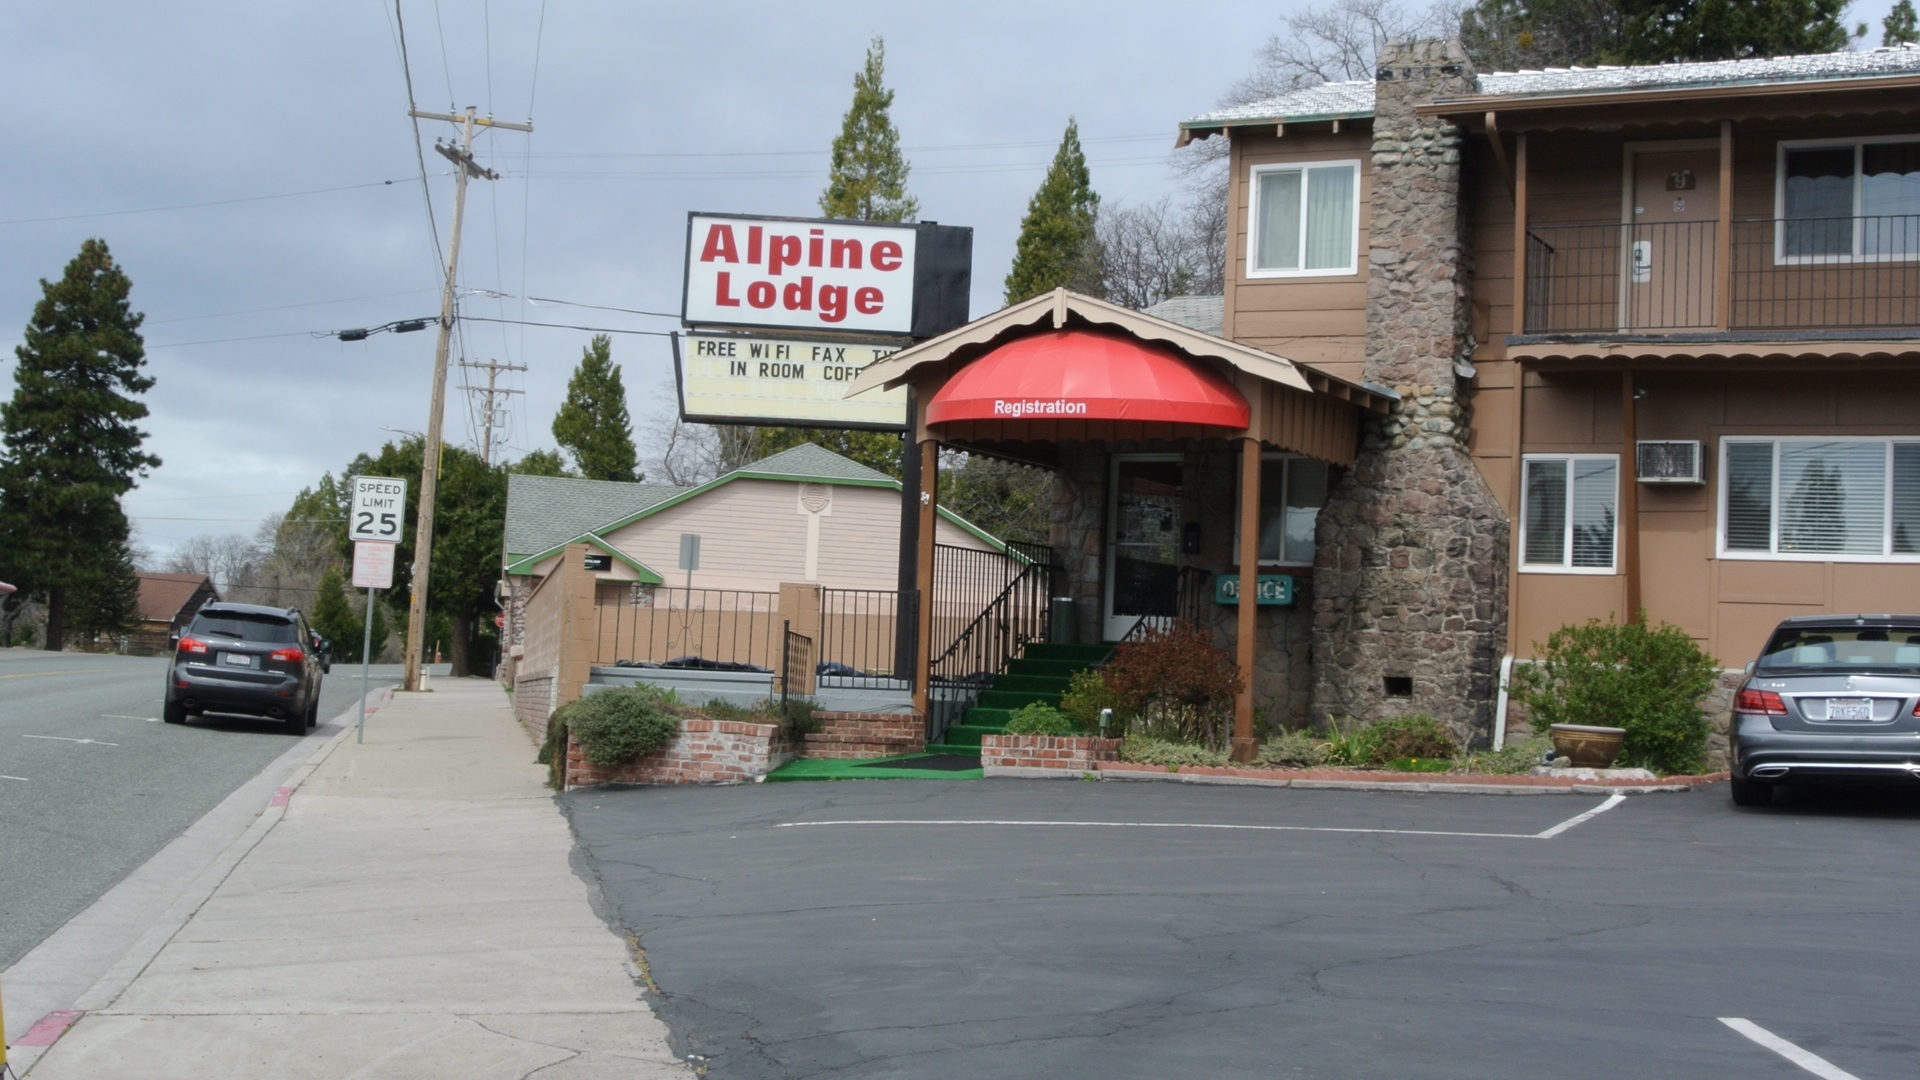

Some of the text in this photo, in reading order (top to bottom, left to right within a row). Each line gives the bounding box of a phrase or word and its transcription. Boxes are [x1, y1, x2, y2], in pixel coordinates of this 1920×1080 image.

[700, 223, 903, 276] Alpine
[716, 271, 884, 323] Lodge
[697, 341, 736, 357] FREE
[812, 346, 846, 363] FAX
[730, 361, 747, 376] IN
[759, 362, 804, 379] ROOM
[994, 399, 1087, 418] Registration
[359, 483, 401, 495] SPEED
[362, 497, 395, 509] LIMIT
[356, 511, 397, 536] 25
[1222, 580, 1286, 600] OICE
[1830, 705, 1870, 717] 7RKE560
